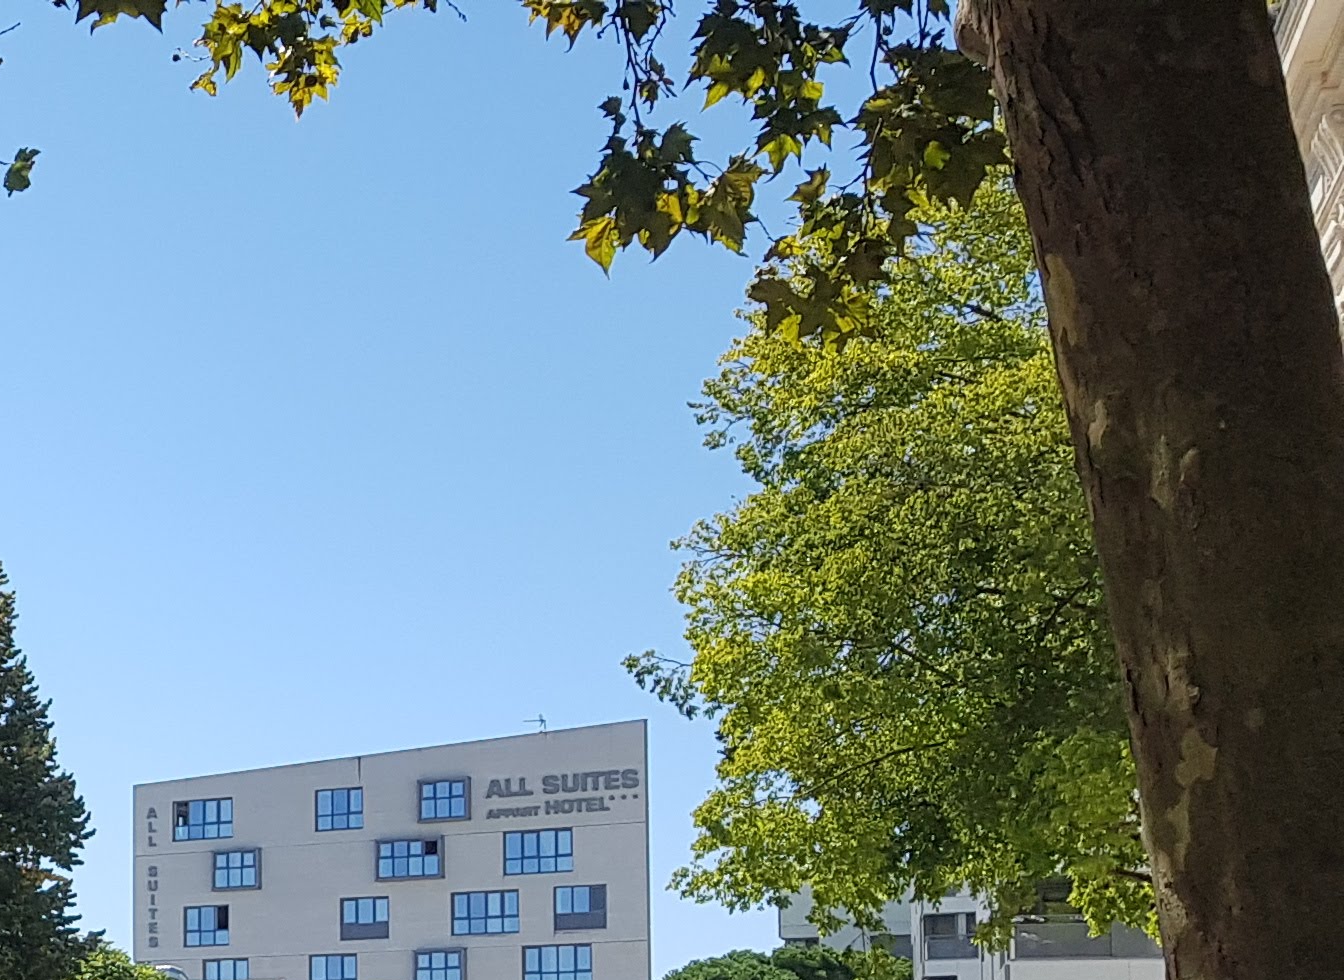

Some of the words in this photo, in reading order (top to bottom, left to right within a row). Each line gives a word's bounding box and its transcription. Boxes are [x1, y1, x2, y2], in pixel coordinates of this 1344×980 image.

[485, 776, 534, 799] ALL
[542, 768, 640, 795] SUITES
[544, 797, 611, 816] HOTEL
[146, 807, 158, 847] ALL
[147, 865, 159, 948] SUITES
